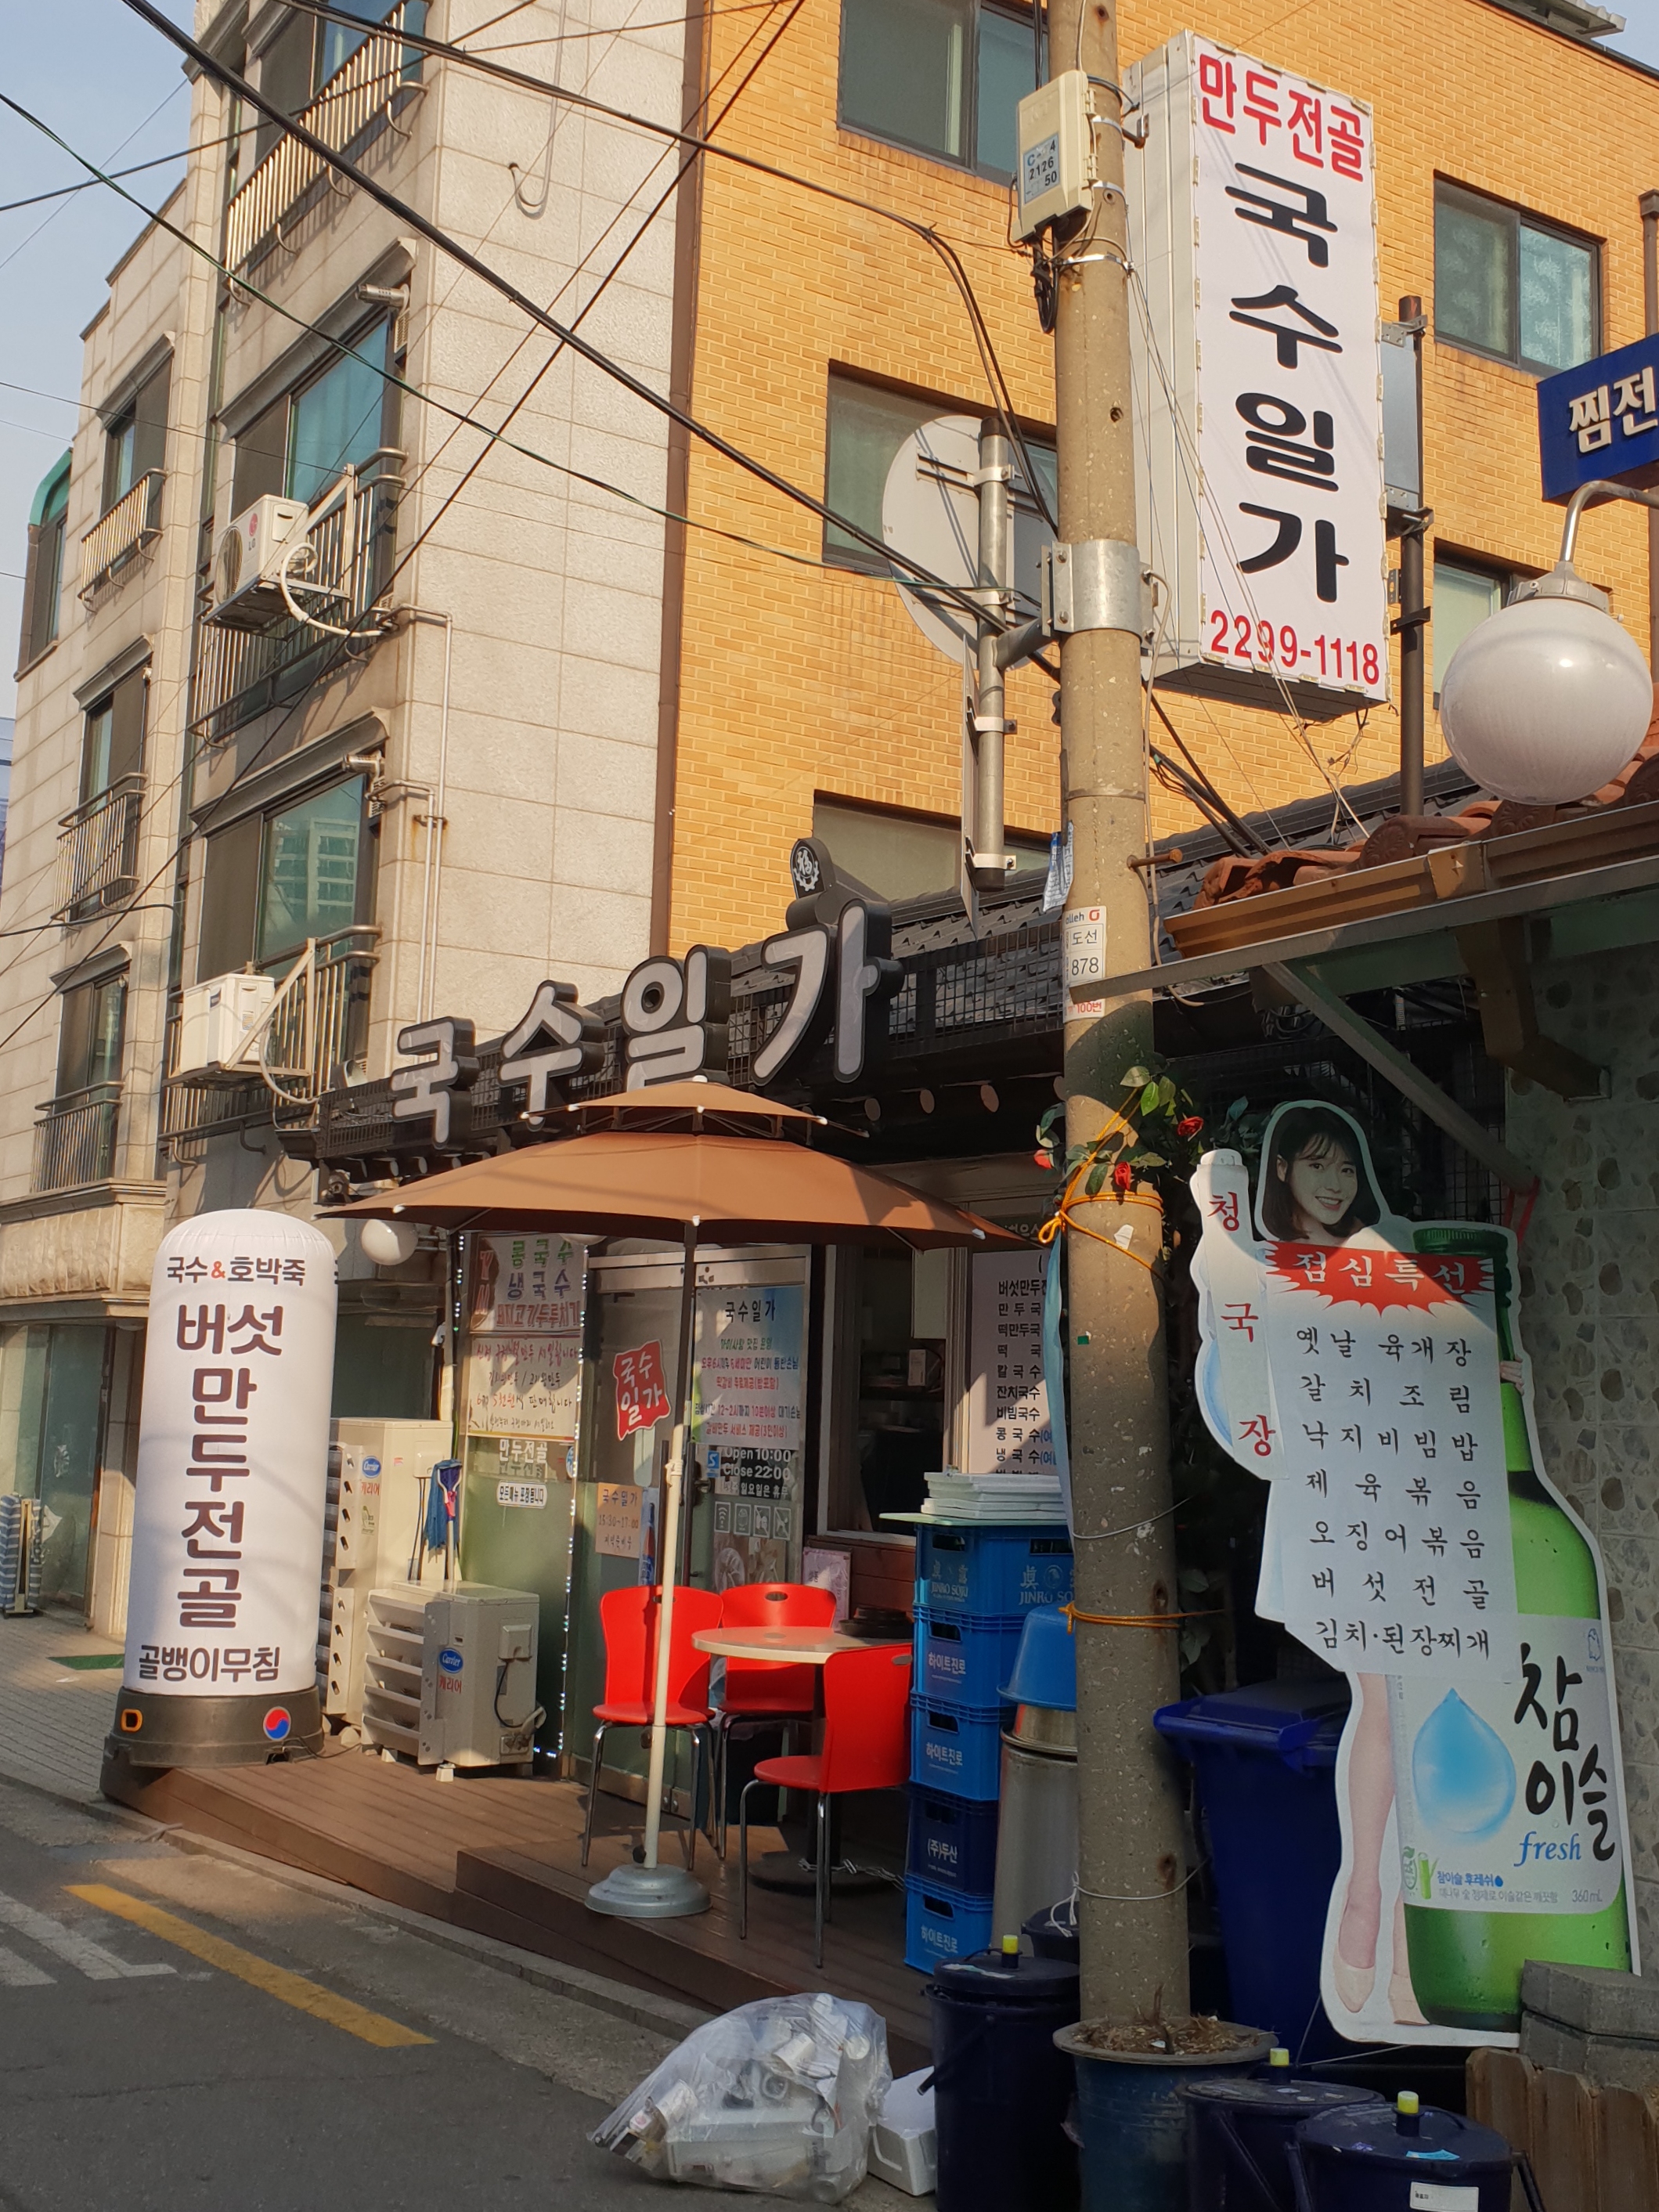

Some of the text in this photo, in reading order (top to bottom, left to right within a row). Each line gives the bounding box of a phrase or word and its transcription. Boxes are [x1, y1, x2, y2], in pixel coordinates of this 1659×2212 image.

[1199, 53, 1365, 182] 만두전골
[1030, 156, 1055, 181] 2126
[1045, 171, 1058, 187] 50
[1224, 163, 1350, 603] 국수일가
[1569, 366, 1658, 453] 찜전
[1210, 610, 1381, 686] 2299-1118
[1072, 929, 1098, 945] 도선
[1072, 957, 1099, 976] 878
[391, 900, 883, 1147] 국수일가
[512, 1239, 573, 1268] 콩국수
[167, 1257, 306, 1286] 국수&호박죽
[507, 1269, 571, 1301] 냉국수
[1293, 1253, 1467, 1295] 점심특선
[725, 1299, 776, 1323] 국수일가
[998, 1302, 1041, 1316] 만두국
[176, 1304, 283, 1357] 버섯
[997, 1323, 1040, 1337] 떡만두국
[1206, 1191, 1276, 1457] 청국장
[1296, 1327, 1472, 1368] 옛날 육개장
[621, 1351, 653, 1387] 국수
[997, 1364, 1041, 1379] 칼국수
[621, 1383, 662, 1427] 일가
[997, 1385, 1040, 1400] 잔치국수
[997, 1406, 1040, 1422] 비빔국수
[500, 1438, 547, 1463] 만두전골
[725, 1447, 792, 1462] Open 10:00
[1301, 1421, 1479, 1463] 낙지비빔밥
[723, 1463, 753, 1477] Close
[755, 1465, 792, 1481] 22:00
[179, 1367, 258, 1629] 만두전골
[603, 1488, 637, 1507] 국수일가
[932, 1581, 950, 1595] JINRO
[951, 1584, 968, 1598] SOJU
[139, 1646, 280, 1683] 골뱅이무침
[929, 1651, 966, 1675] 하이트진로
[925, 1741, 963, 1766] 하이트진로
[1514, 1642, 1615, 1861] 참이슬
[927, 1838, 958, 1864] (주)두산
[1514, 1831, 1581, 1867] fresh
[1437, 1871, 1462, 1885] 참이슬
[921, 1924, 958, 1954] 하이트진로
